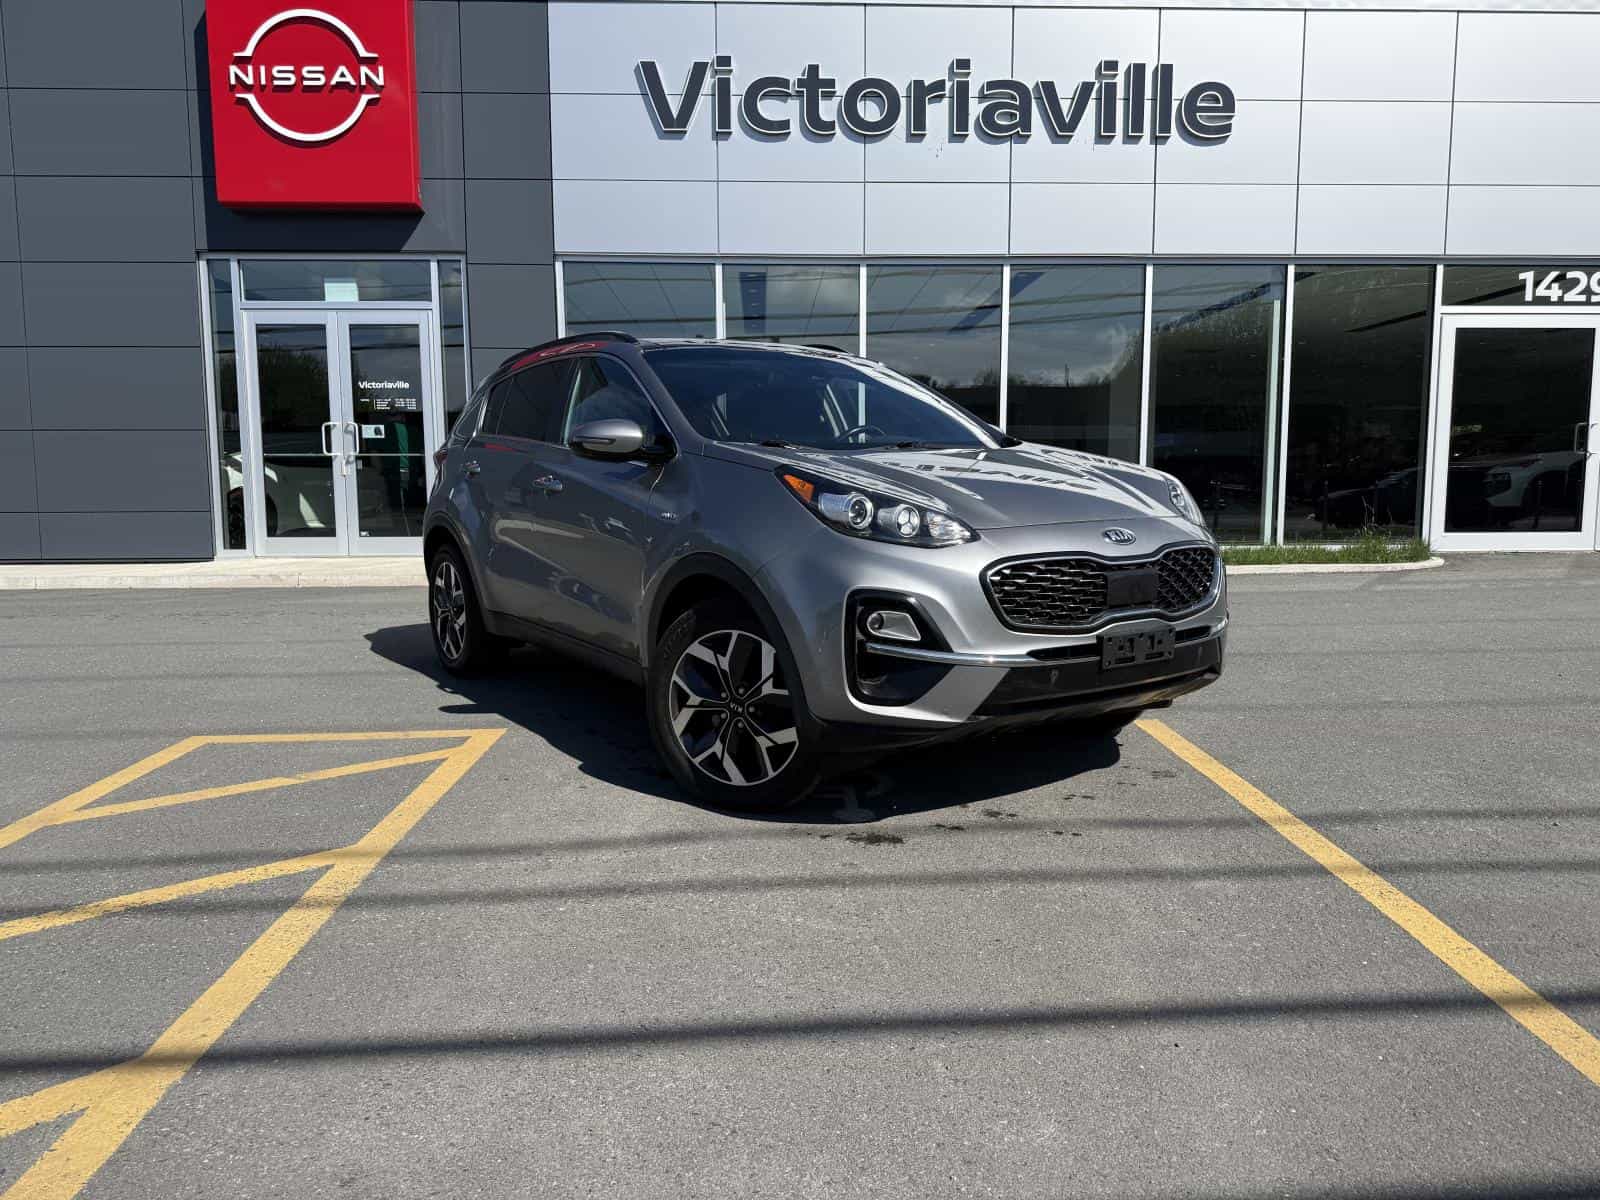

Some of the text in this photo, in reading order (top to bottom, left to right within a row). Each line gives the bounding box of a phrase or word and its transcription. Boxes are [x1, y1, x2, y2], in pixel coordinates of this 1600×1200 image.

[228, 65, 385, 86] NISSAN
[637, 55, 1236, 138] Victoriaville
[358, 380, 410, 389] Victoriaville
[1105, 529, 1134, 542] KIA
